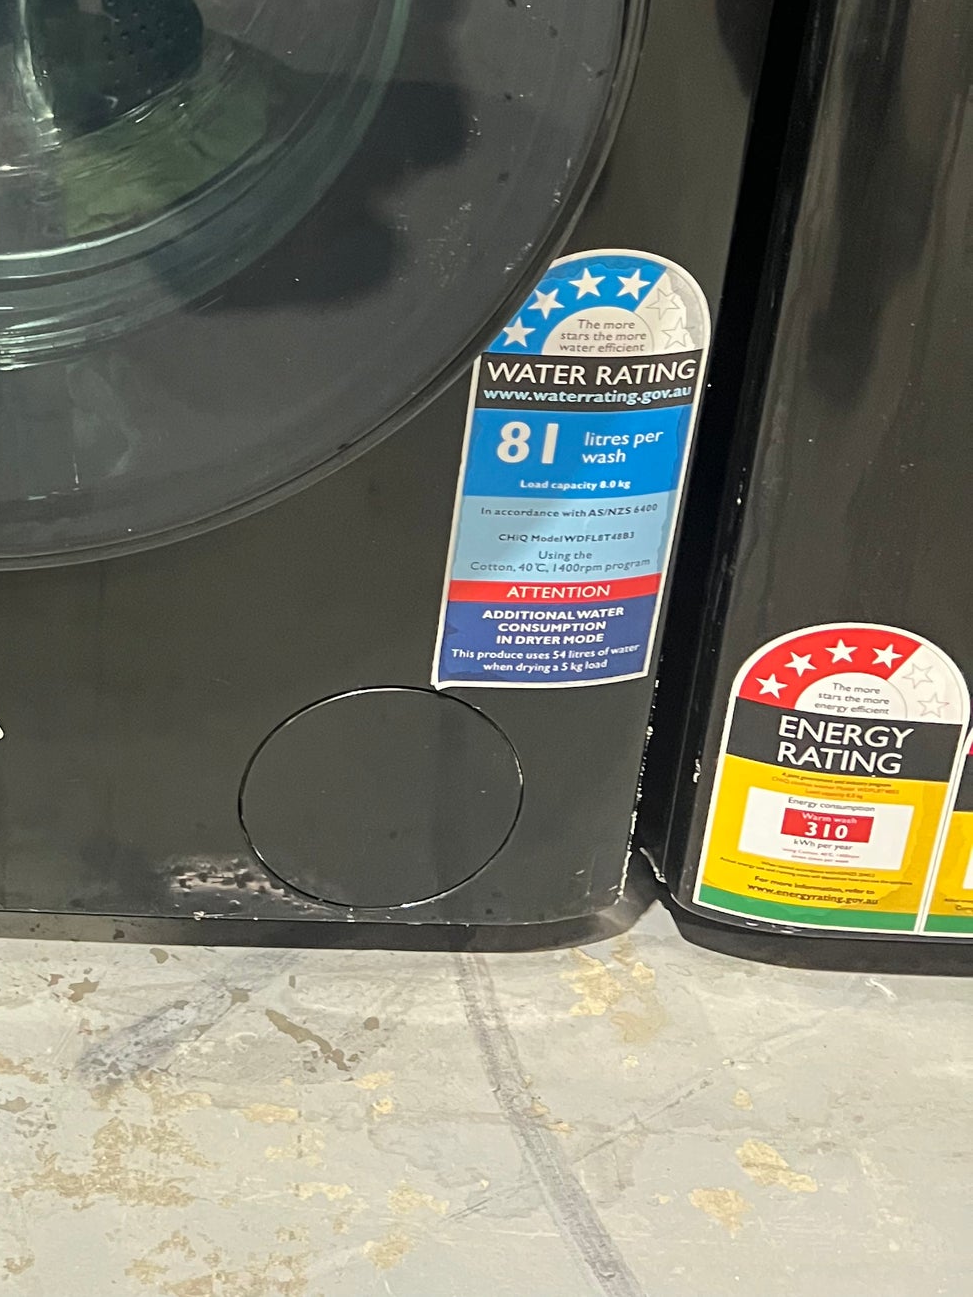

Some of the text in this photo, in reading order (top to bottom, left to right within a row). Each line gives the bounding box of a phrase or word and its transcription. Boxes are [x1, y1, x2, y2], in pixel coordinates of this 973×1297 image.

[577, 319, 635, 330] The more
[560, 331, 647, 341] stars the more
[559, 343, 645, 353] water efficient
[487, 358, 697, 386] WATER RATING
[483, 386, 692, 406] www.waterrating.gov.au
[497, 421, 664, 464] 81 litres per
[582, 449, 626, 464] wash
[520, 479, 631, 491] Load capacity 8.0 kg
[481, 503, 658, 517] In accordance with AS/NZS 6400
[531, 534, 563, 543] Model
[538, 550, 593, 561] Using the
[470, 561, 516, 573] Cotton,
[552, 563, 603, 574] 1400rpm
[605, 559, 651, 572] program
[506, 585, 611, 599] ATTENTION
[482, 606, 624, 620] ADDITIONAL WATER
[497, 620, 607, 633] CONSUMPTION
[496, 633, 605, 645] IN DRYER MODE
[451, 644, 641, 661] This produce uses 54 litres of water
[483, 662, 513, 671] when
[515, 663, 551, 674] drying
[561, 662, 568, 671] 5
[570, 661, 584, 672] kg
[585, 659, 608, 669] load
[832, 682, 881, 694] The more
[818, 692, 890, 705] stars the more
[814, 702, 890, 715] energy efficient
[778, 714, 915, 749] ENERGY
[777, 741, 903, 775] RATING
[788, 797, 876, 812] Energy consumption
[801, 812, 858, 824] Warm wash
[804, 821, 849, 840] 310
[793, 838, 853, 851] kWh per year
